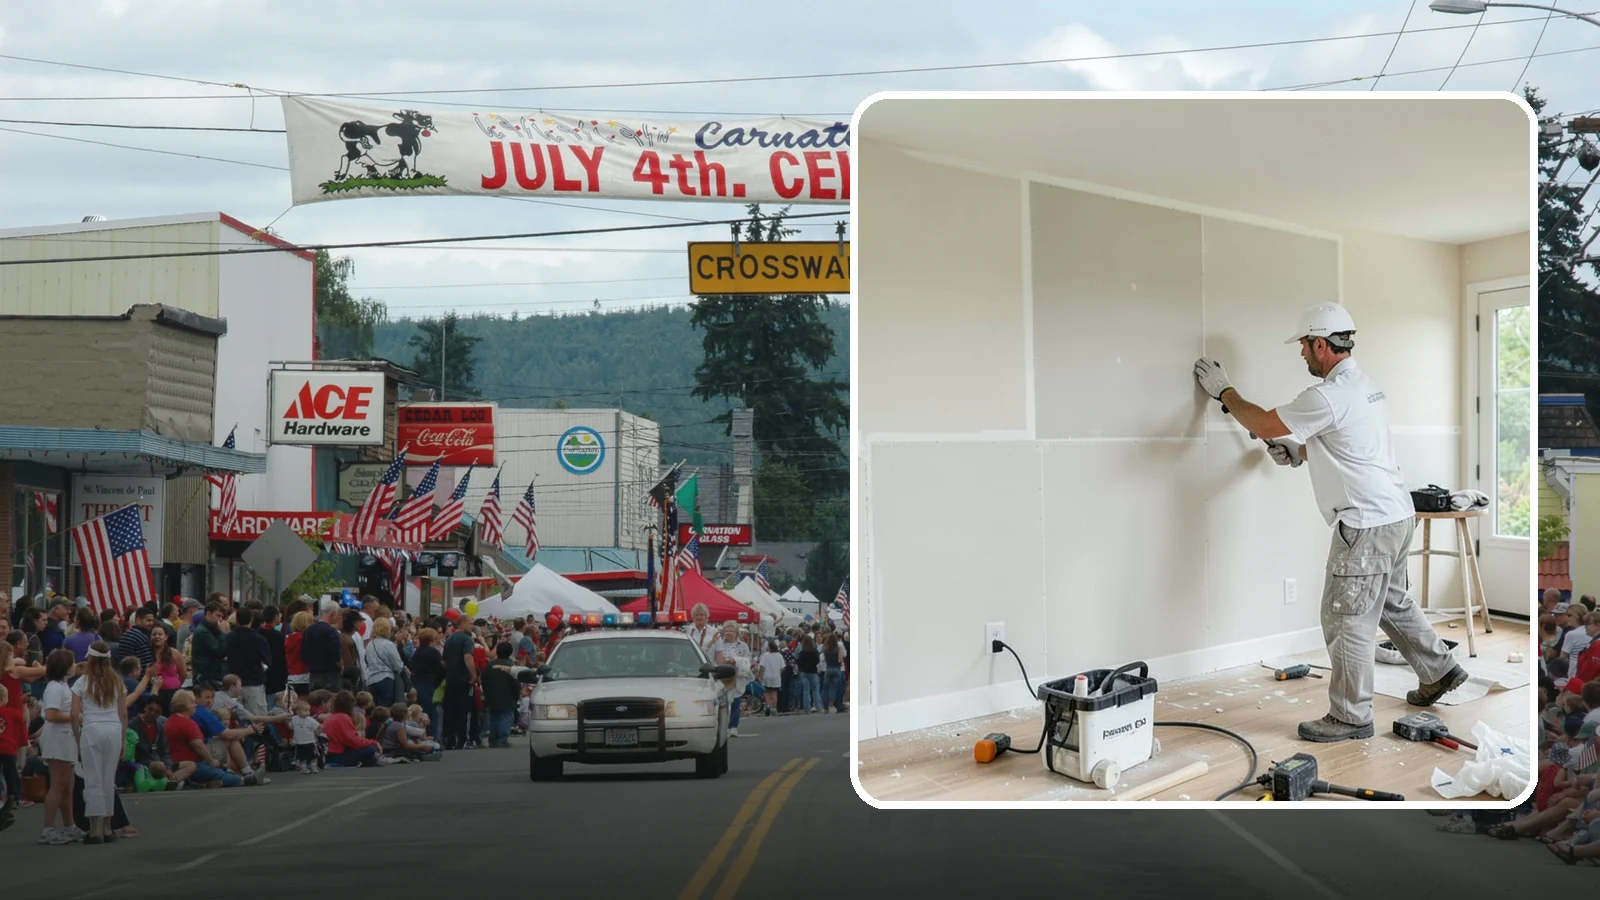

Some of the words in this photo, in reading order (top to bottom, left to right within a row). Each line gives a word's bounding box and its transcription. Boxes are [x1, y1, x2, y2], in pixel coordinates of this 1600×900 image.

[481, 140, 604, 193] JULY
[632, 150, 746, 198] 4th.
[697, 254, 850, 280] CROSSWA
[283, 380, 373, 420] ACE
[406, 409, 453, 422] CEDAR
[283, 421, 371, 437] Hardware
[416, 428, 477, 447] Coca-Cola
[353, 467, 384, 481] Simpl
[83, 484, 93, 494] St.
[95, 485, 124, 495] Vincent
[126, 485, 135, 494] de
[137, 486, 155, 495] Paul
[688, 526, 741, 535] CRNATION
[699, 535, 730, 543] GLASS
